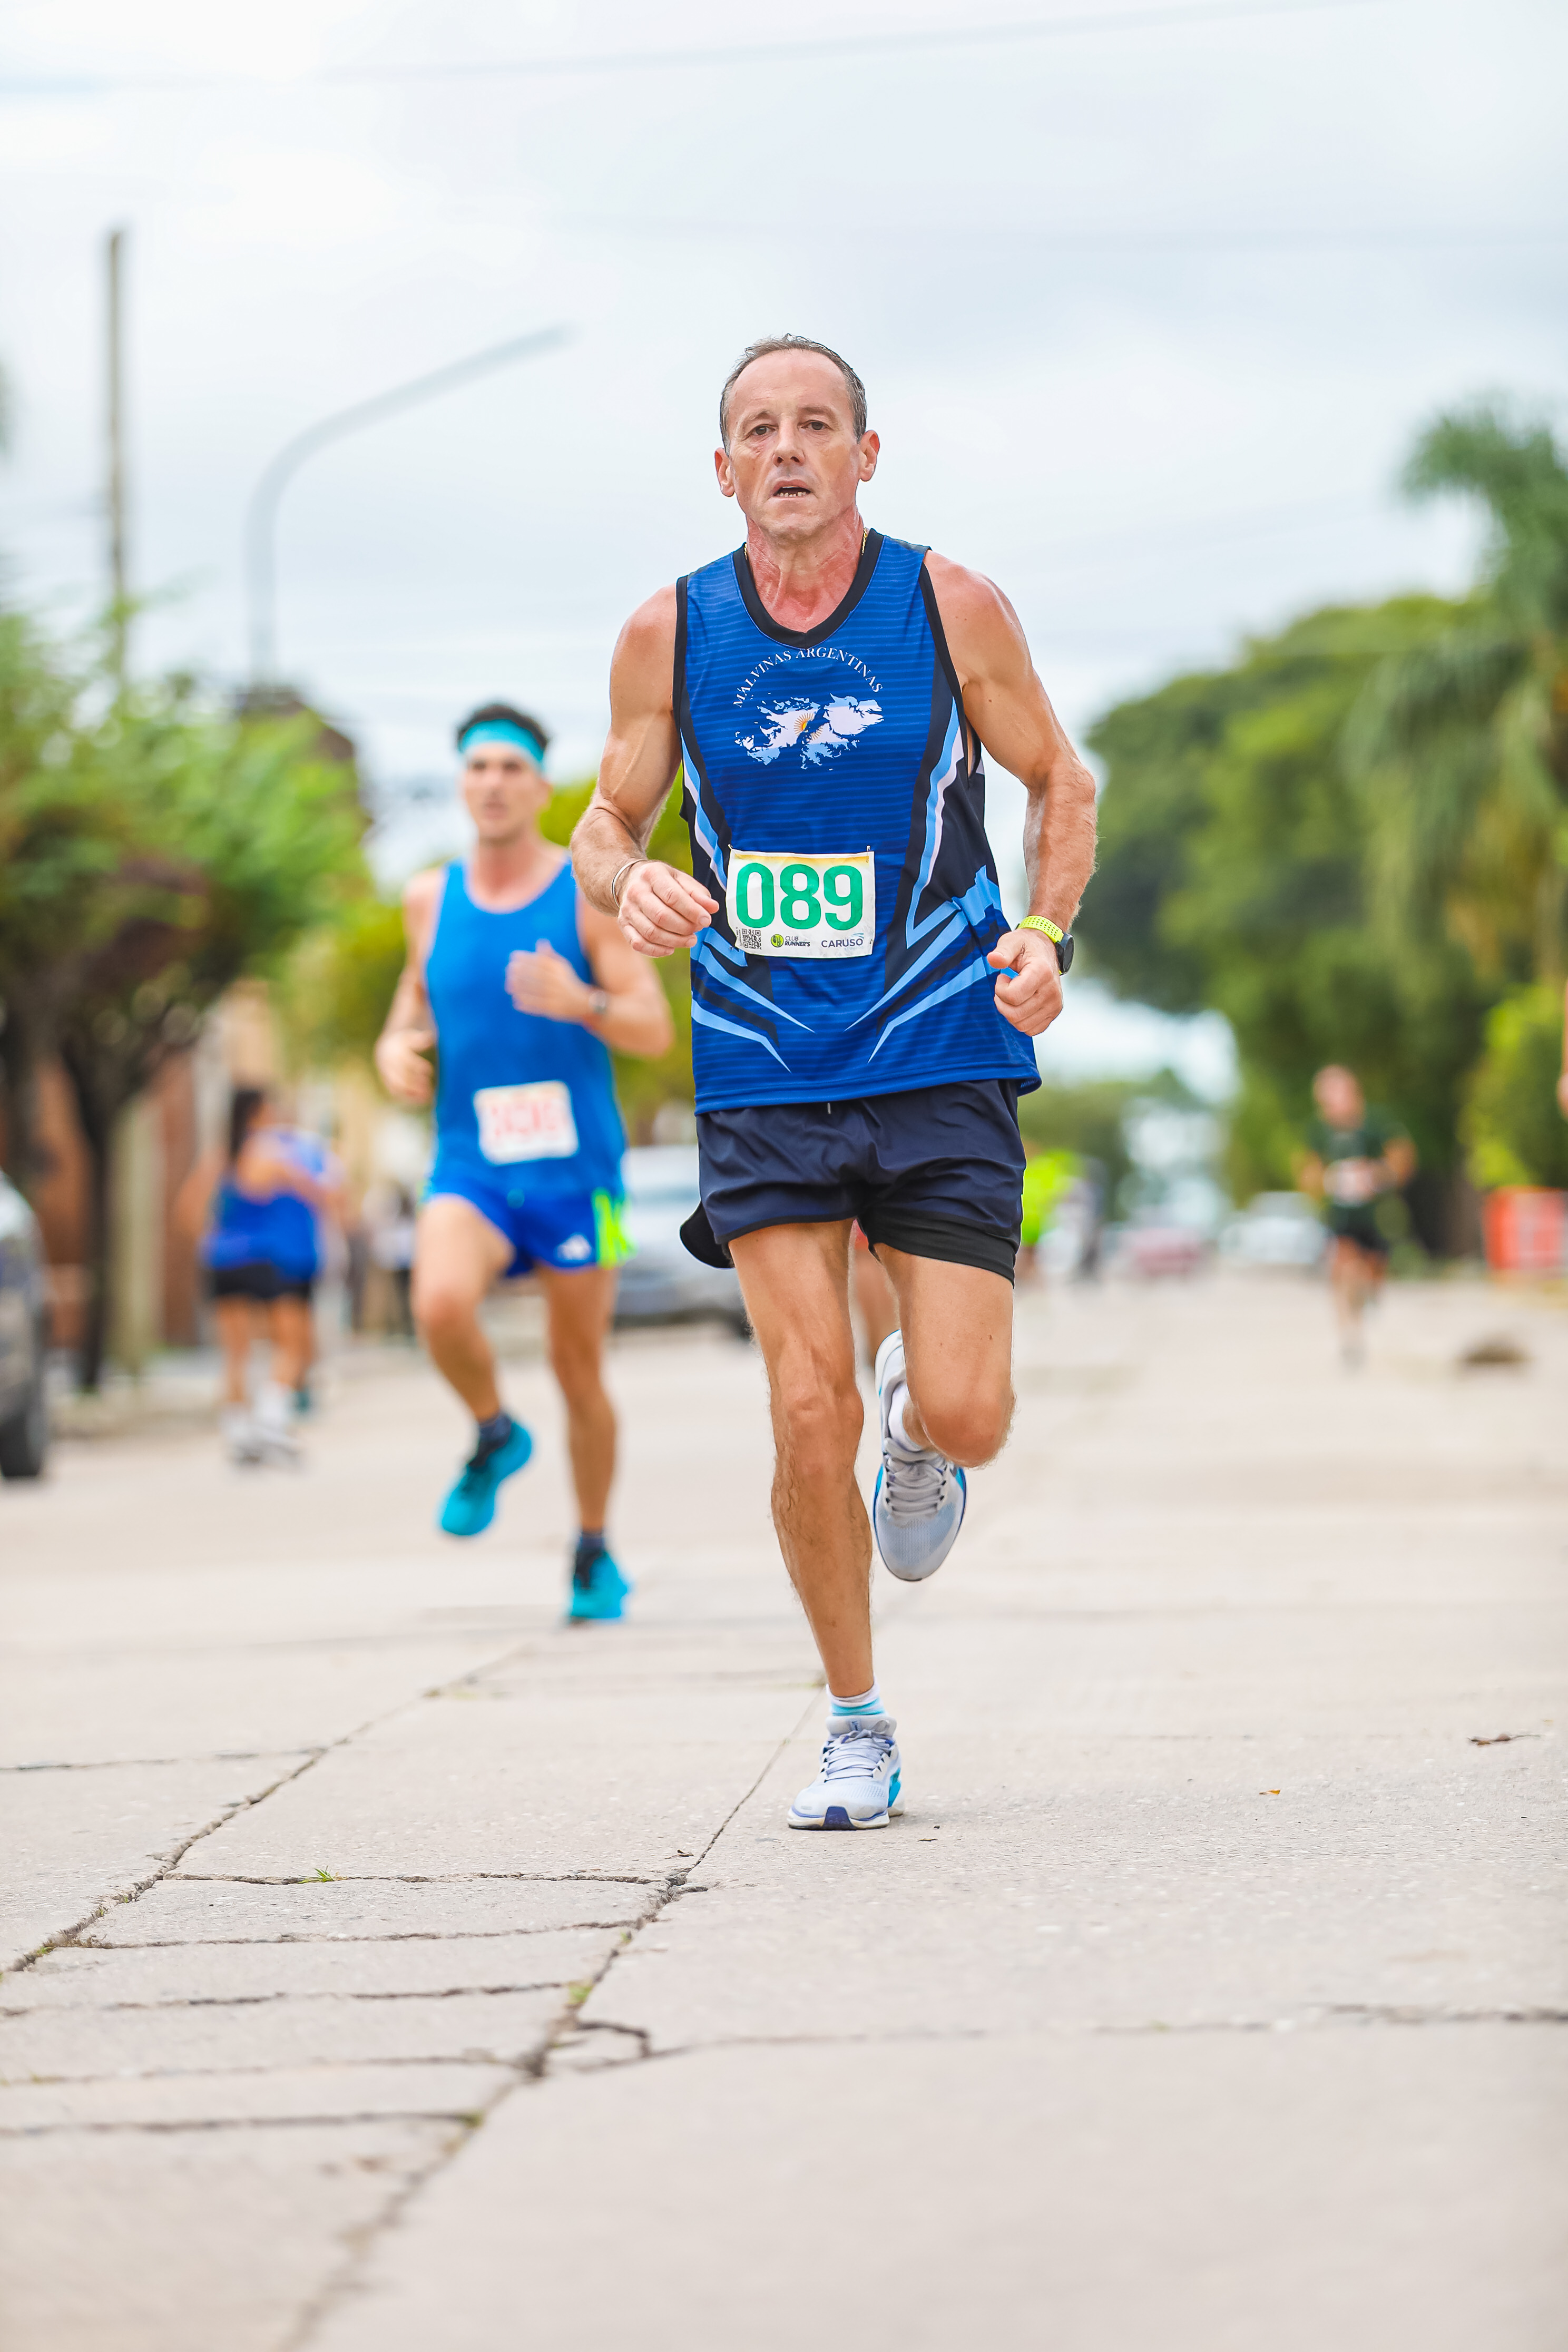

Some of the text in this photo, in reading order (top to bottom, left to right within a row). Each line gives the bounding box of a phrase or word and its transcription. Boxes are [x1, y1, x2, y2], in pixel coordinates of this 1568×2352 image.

[733, 646, 883, 708] MALVINAS ARGENTINAS
[736, 863, 863, 930] 089
[821, 938, 863, 948] CARUSO
